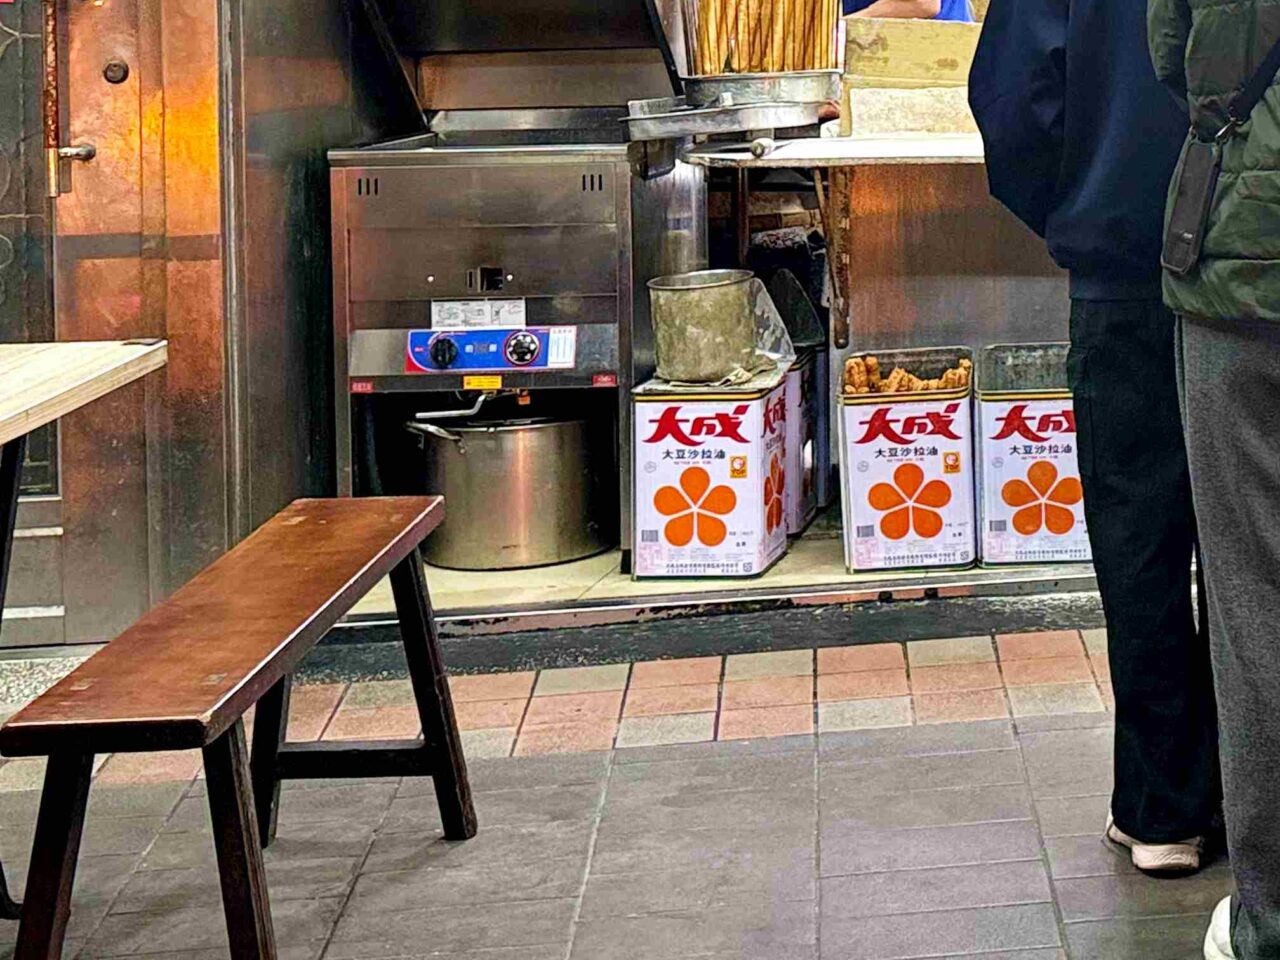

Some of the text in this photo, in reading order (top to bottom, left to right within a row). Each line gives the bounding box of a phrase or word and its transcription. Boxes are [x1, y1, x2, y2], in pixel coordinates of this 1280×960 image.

[642, 404, 751, 447] 大成
[853, 403, 963, 445] 大成
[662, 448, 726, 460] 大豆沙拉油
[874, 446, 939, 459] 大豆沙拉油
[1009, 444, 1073, 456] 大豆沙拉油
